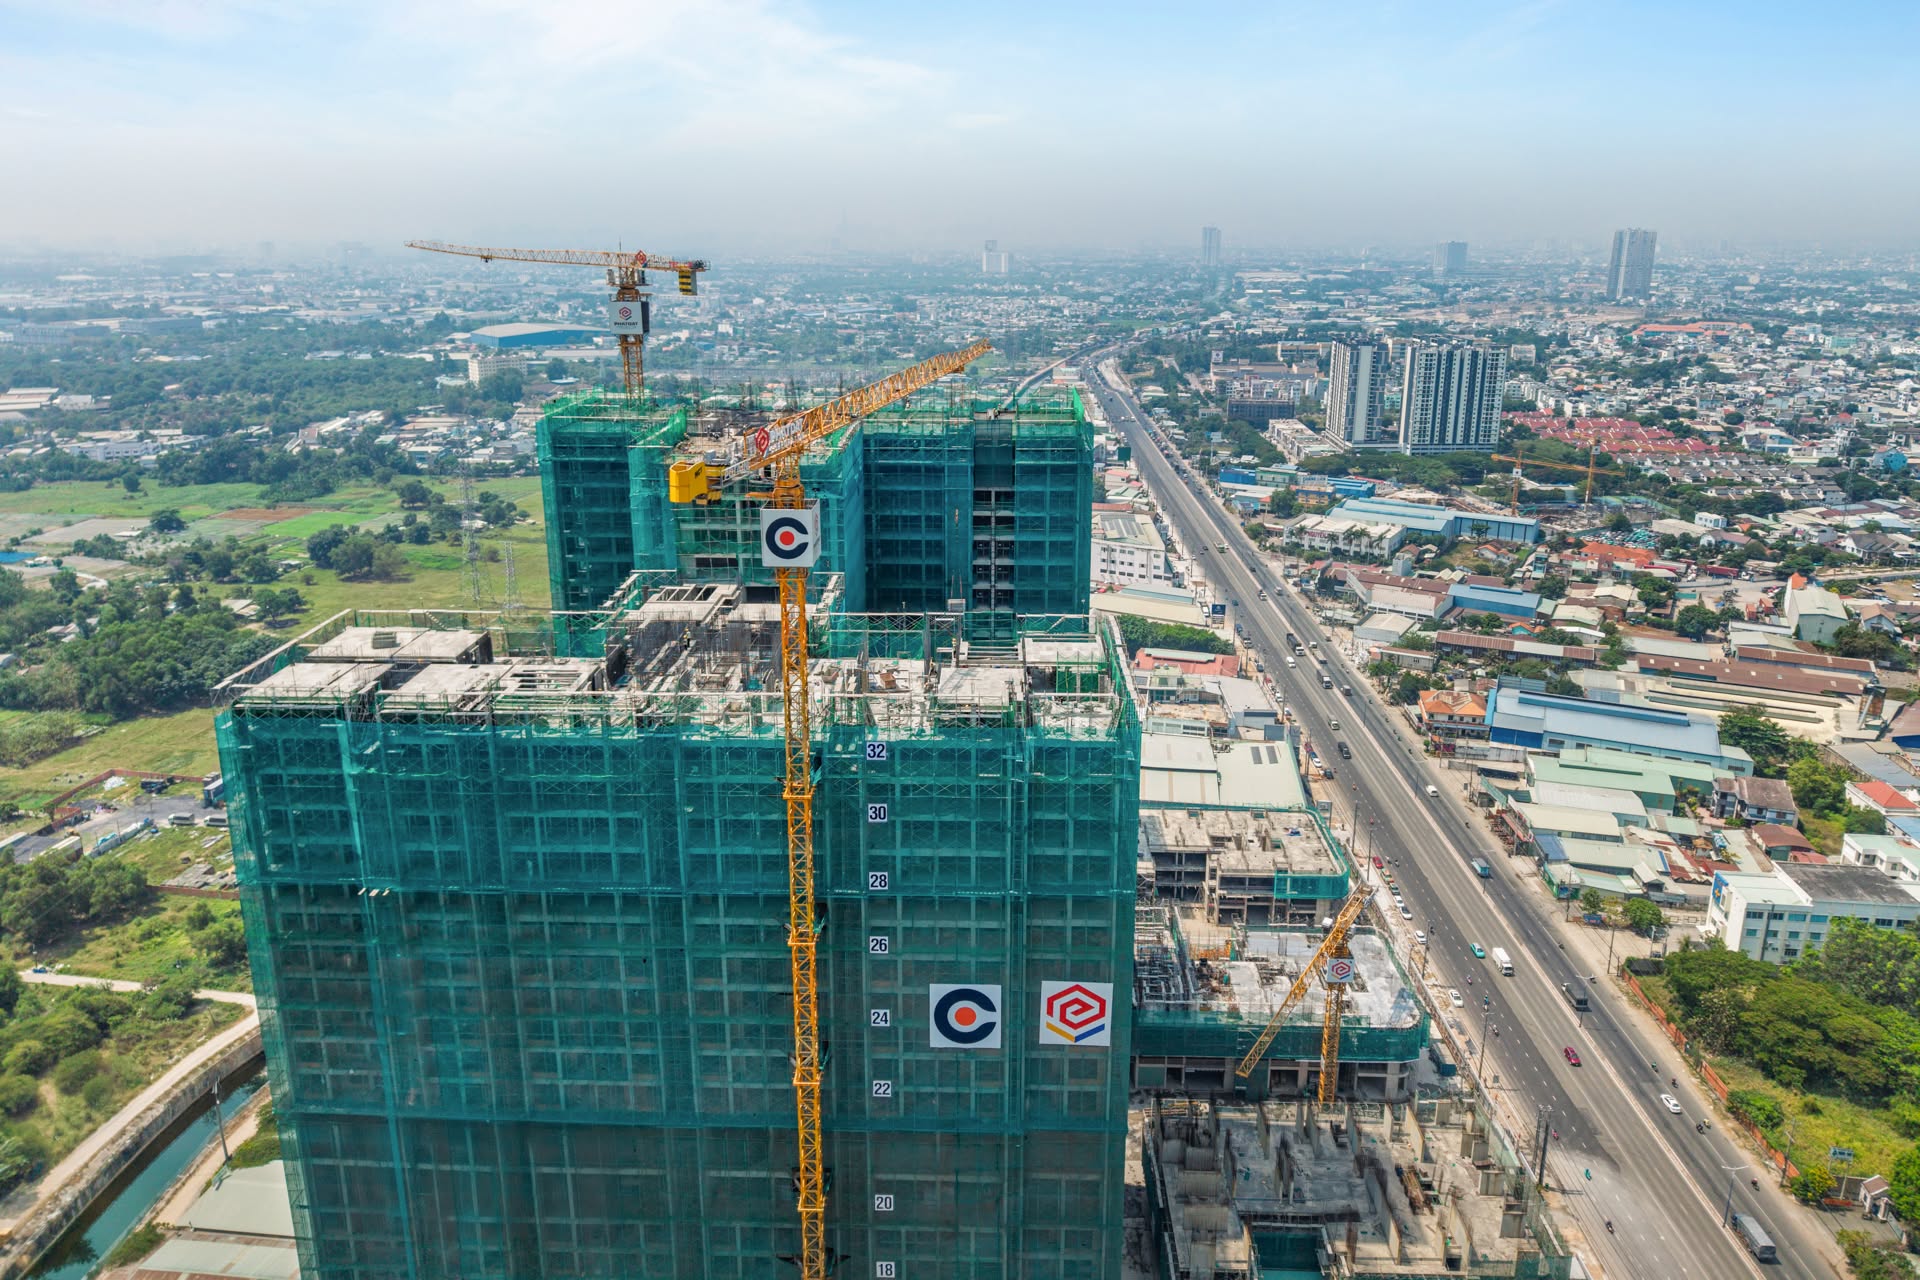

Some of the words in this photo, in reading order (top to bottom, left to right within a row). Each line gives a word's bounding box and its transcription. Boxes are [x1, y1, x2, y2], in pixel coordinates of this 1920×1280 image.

[867, 743, 885, 758] 32
[869, 805, 886, 820] 30
[870, 874, 887, 888] 28
[871, 938, 887, 952] 26
[872, 1011, 888, 1024] 24
[874, 1082, 890, 1095] 22
[876, 1196, 892, 1209] 20
[878, 1263, 893, 1276] 18
